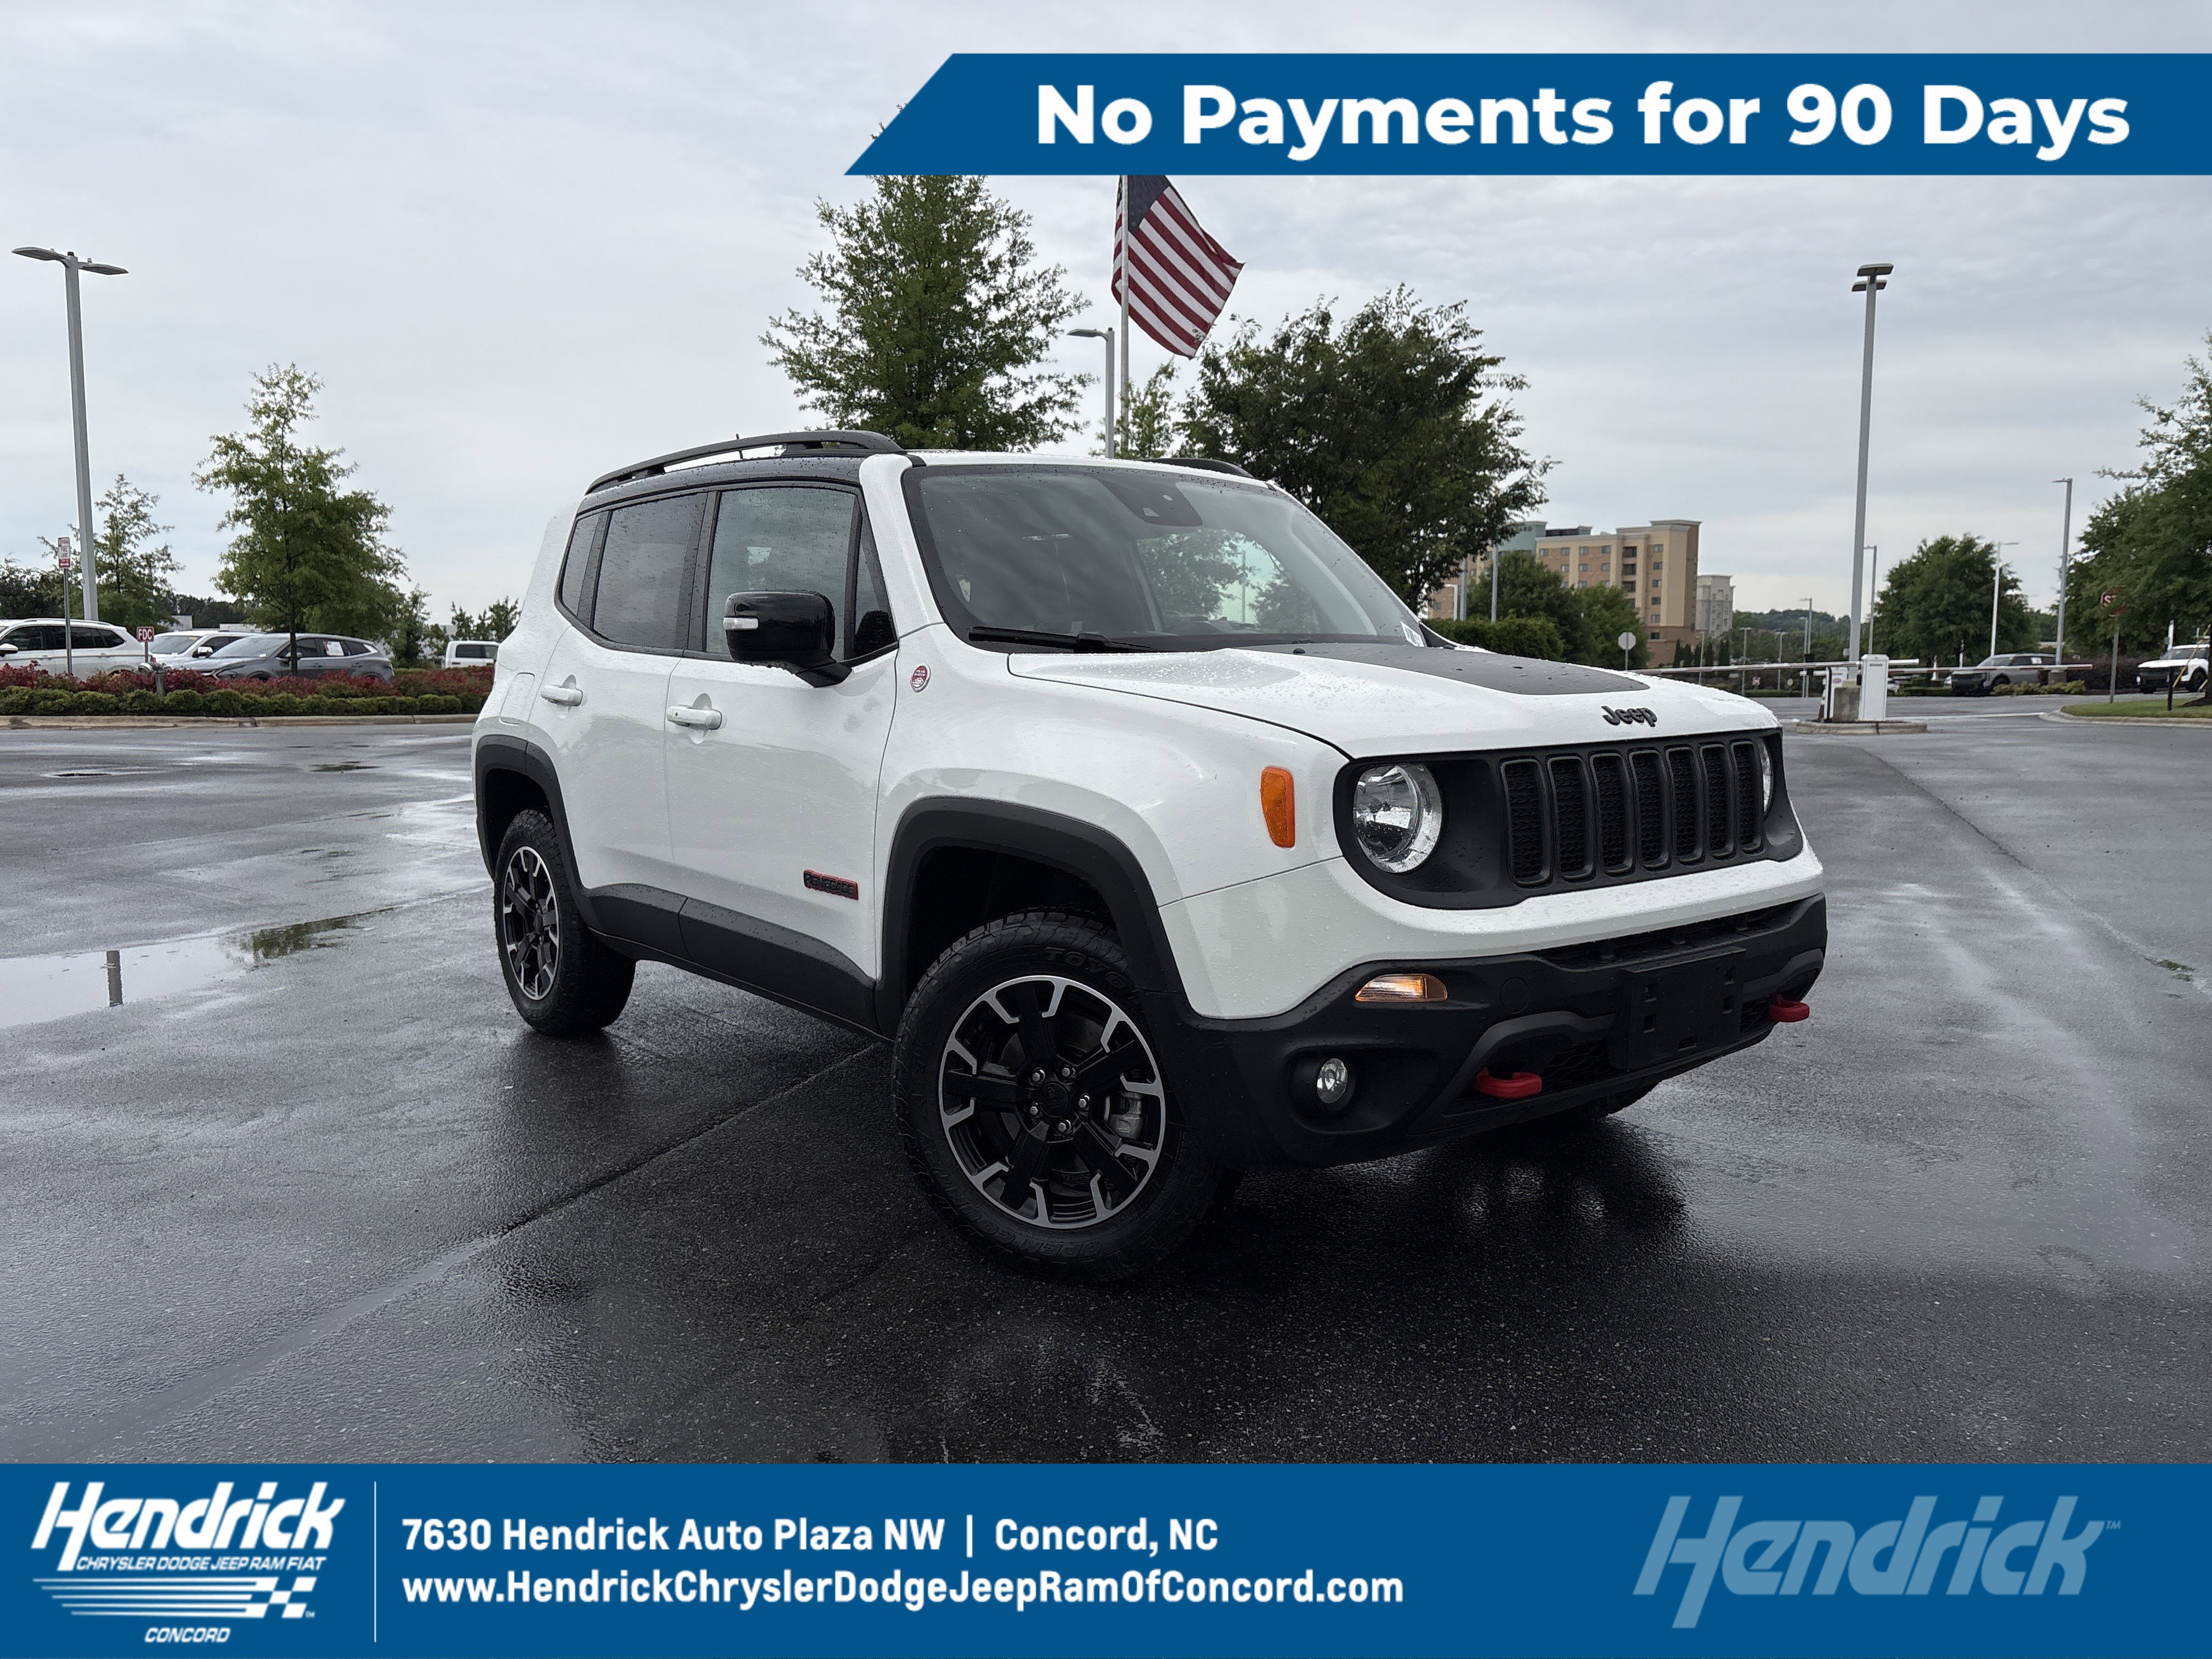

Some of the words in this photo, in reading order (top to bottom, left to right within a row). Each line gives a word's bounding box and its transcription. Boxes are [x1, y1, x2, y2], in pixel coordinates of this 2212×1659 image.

[138, 628, 153, 640] FDC
[1601, 706, 1657, 727] Jeep
[1043, 946, 1127, 989] TOYO
[1018, 1238, 1102, 1259] OPEN
